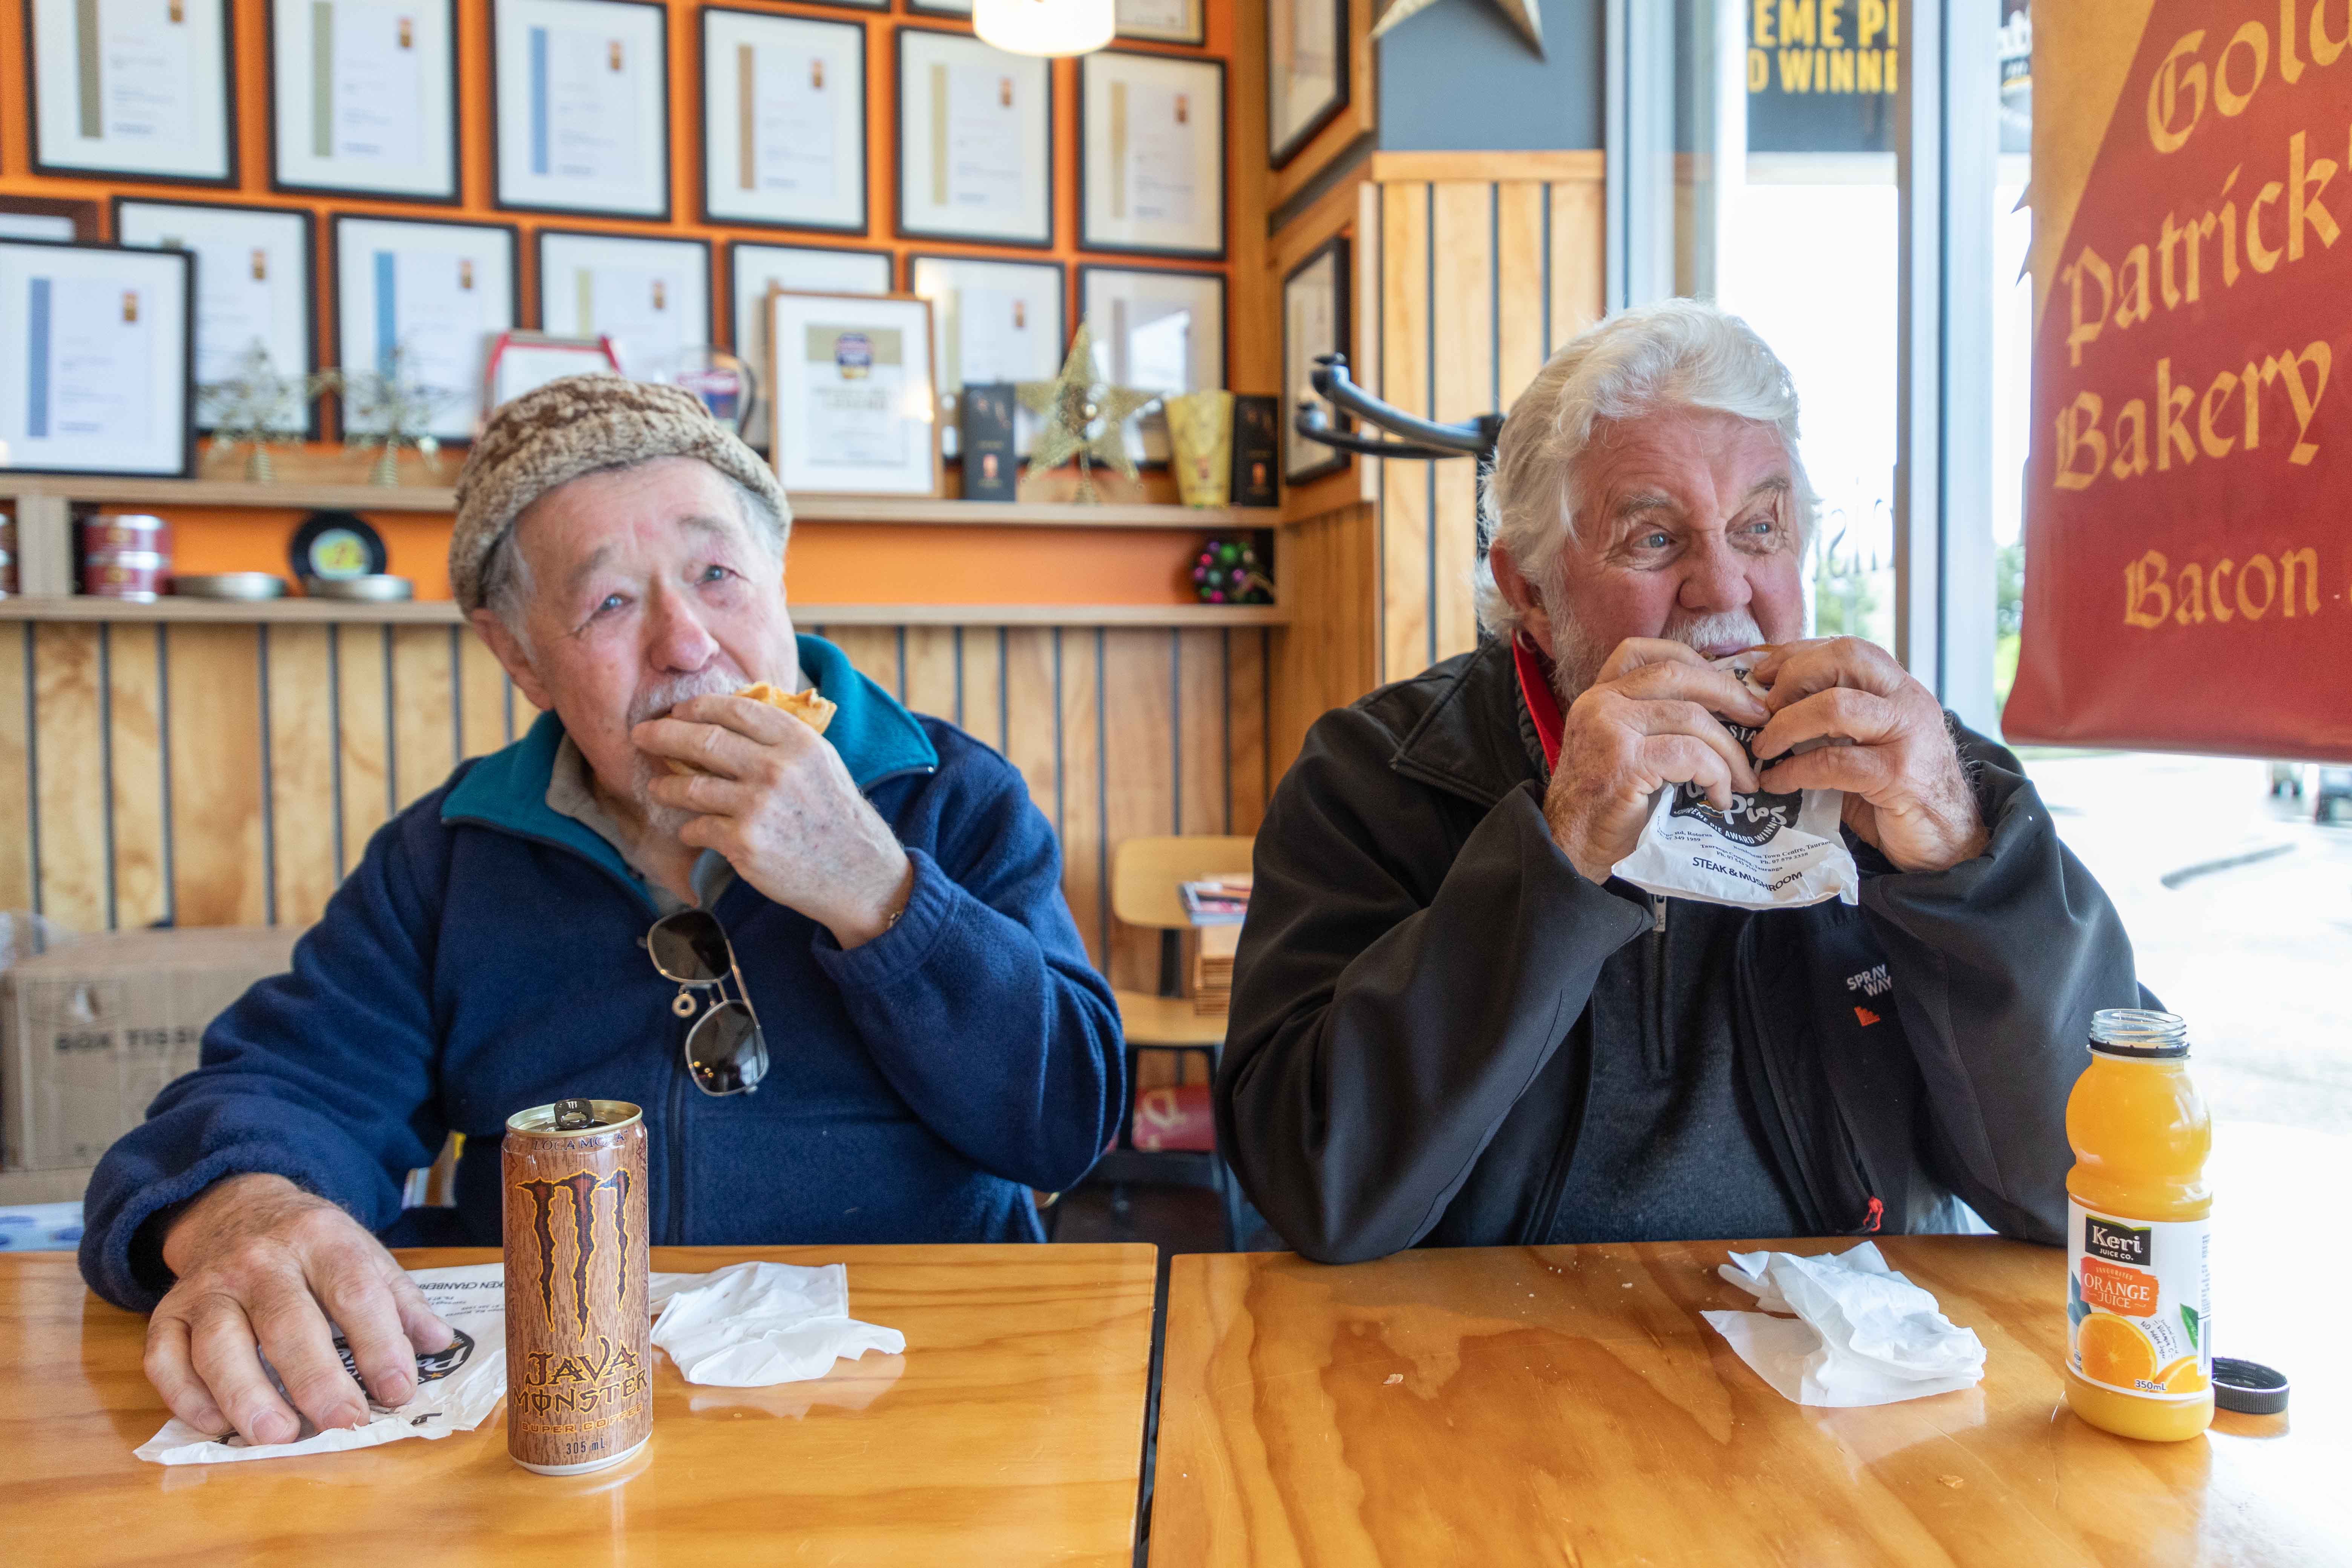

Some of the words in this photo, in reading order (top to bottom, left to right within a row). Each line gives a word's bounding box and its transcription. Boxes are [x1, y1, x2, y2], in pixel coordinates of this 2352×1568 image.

[1748, 0, 1844, 48] EME
[2053, 340, 2332, 491] Bakery
[2123, 547, 2321, 629] Bacon
[1709, 822, 1723, 835] PIE
[1725, 830, 1755, 844] AWARD
[1782, 846, 1806, 856] Centre,
[1692, 857, 1728, 874] STEAK
[1729, 868, 1738, 877] &
[1739, 871, 1803, 891] MUSHROOM
[1847, 964, 1887, 991] SPRAY
[1863, 975, 1892, 997] WAY
[533, 1139, 576, 1151] LOCA
[2092, 1225, 2142, 1254] Keri
[2099, 1248, 2119, 1258] JUICE
[2120, 1252, 2134, 1261] CO.
[2084, 1272, 2150, 1301] ORANGE
[2097, 1291, 2131, 1308] JUICE
[524, 1334, 640, 1390] JAVA
[2135, 1379, 2166, 1391] 350mL
[521, 1421, 577, 1434] SUPER
[581, 1401, 643, 1432] COFFEE
[566, 1441, 586, 1455] 305
[591, 1437, 606, 1450] mL
